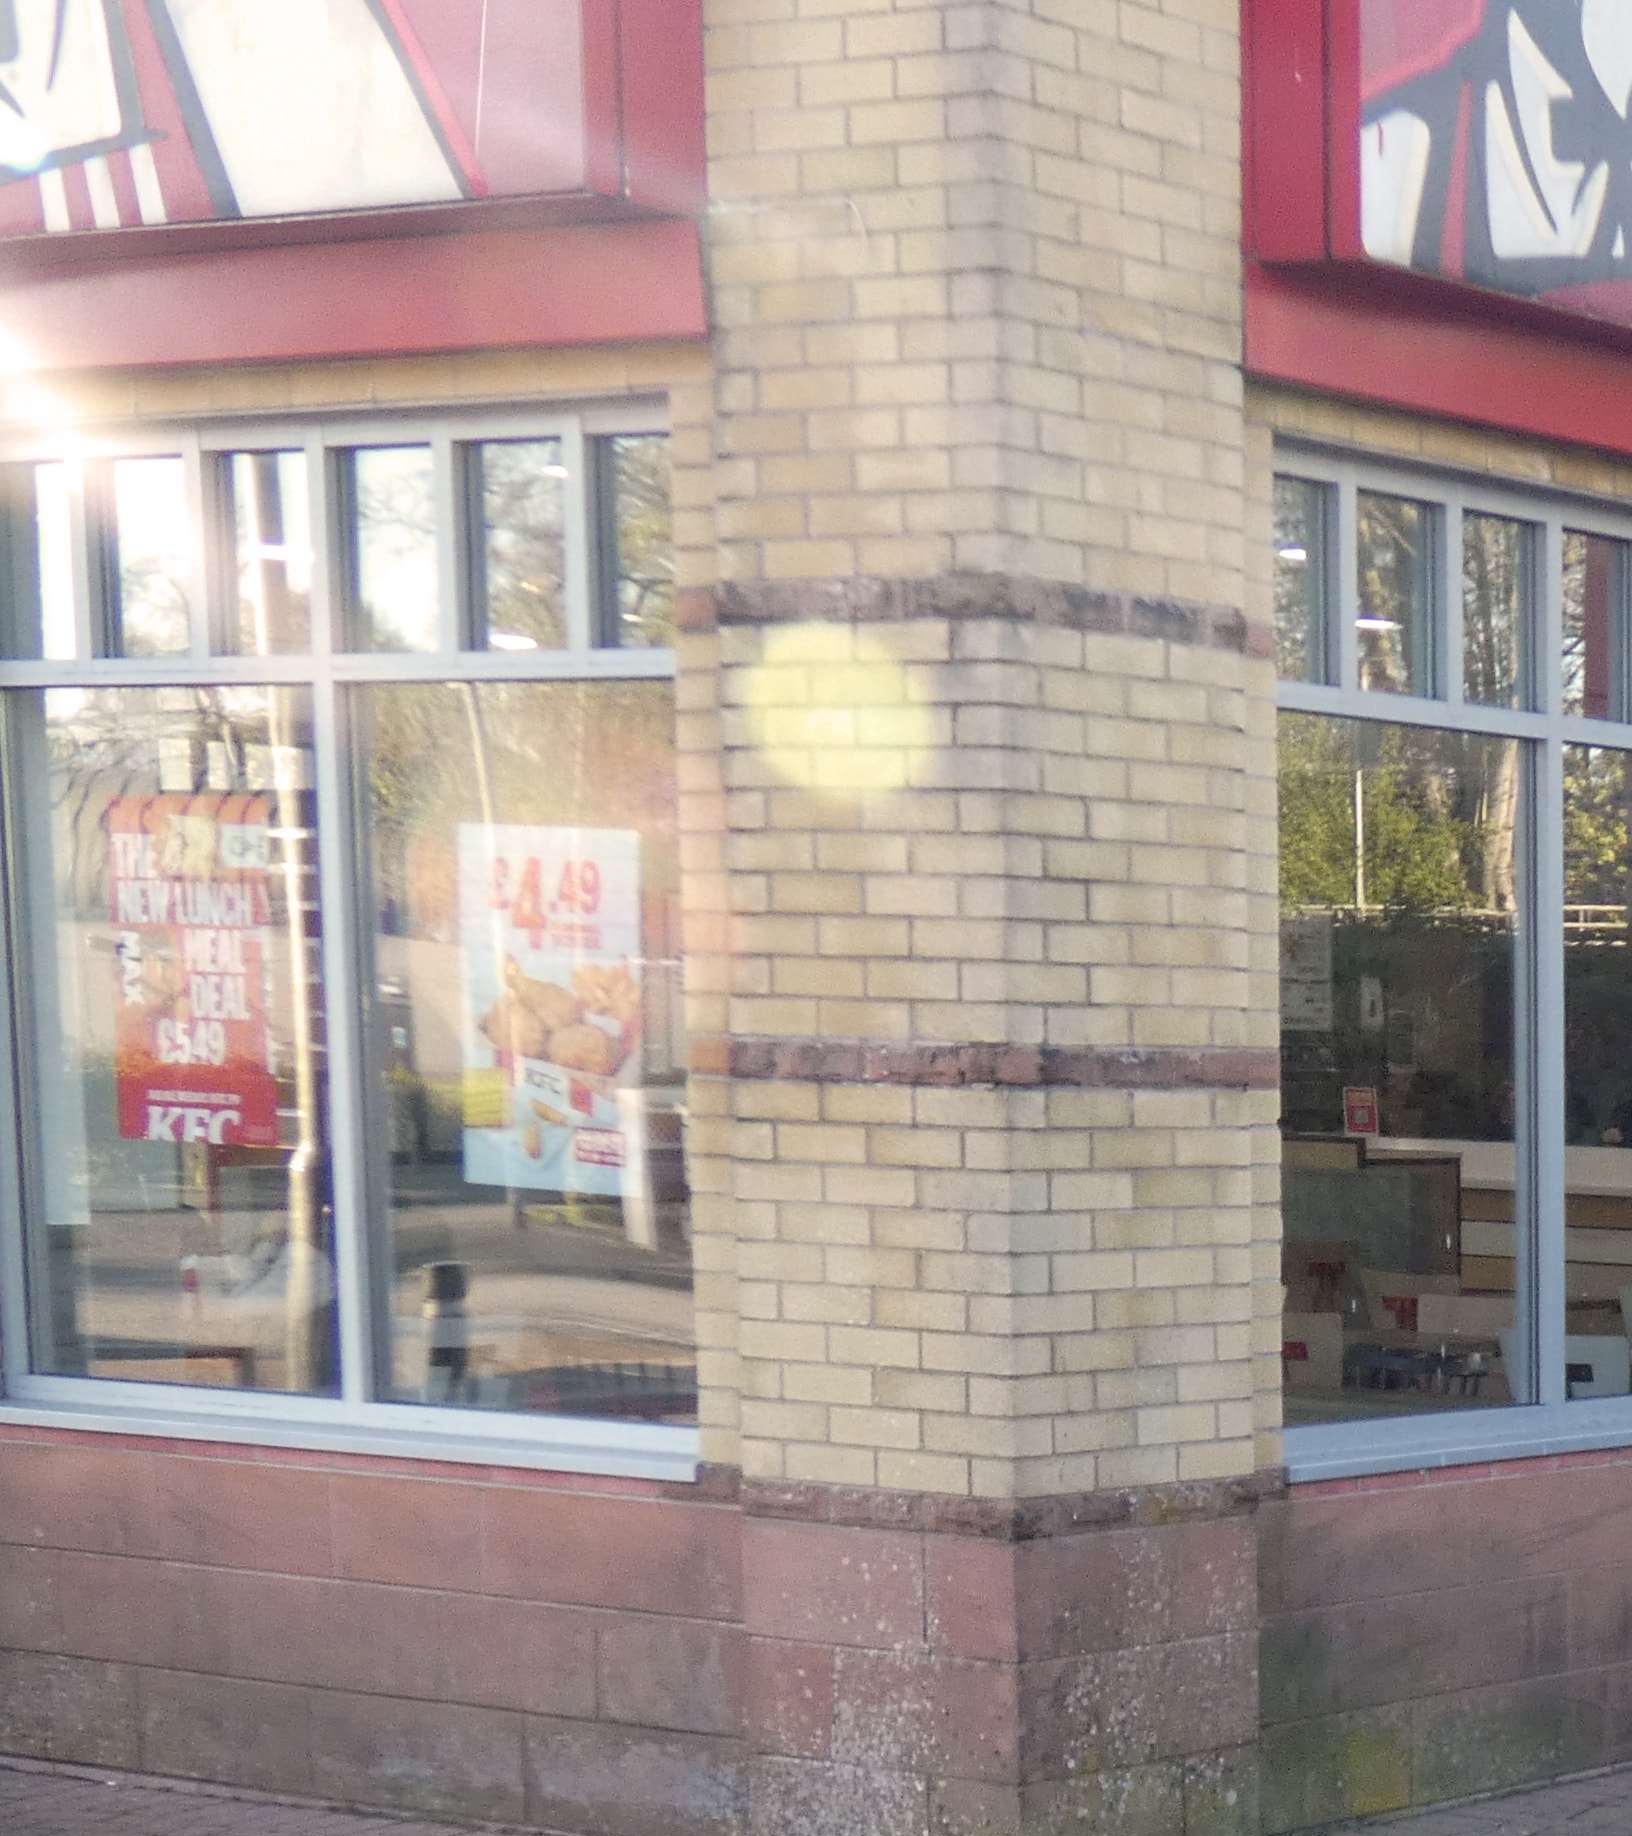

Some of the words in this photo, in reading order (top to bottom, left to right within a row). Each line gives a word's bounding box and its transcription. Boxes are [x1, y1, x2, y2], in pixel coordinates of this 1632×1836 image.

[112, 833, 157, 878] THE
[118, 879, 170, 923] NEW
[174, 881, 252, 926] LUNCH
[184, 928, 246, 973] MEAL
[191, 974, 250, 1020] DEAL
[146, 1105, 241, 1144] KFC
